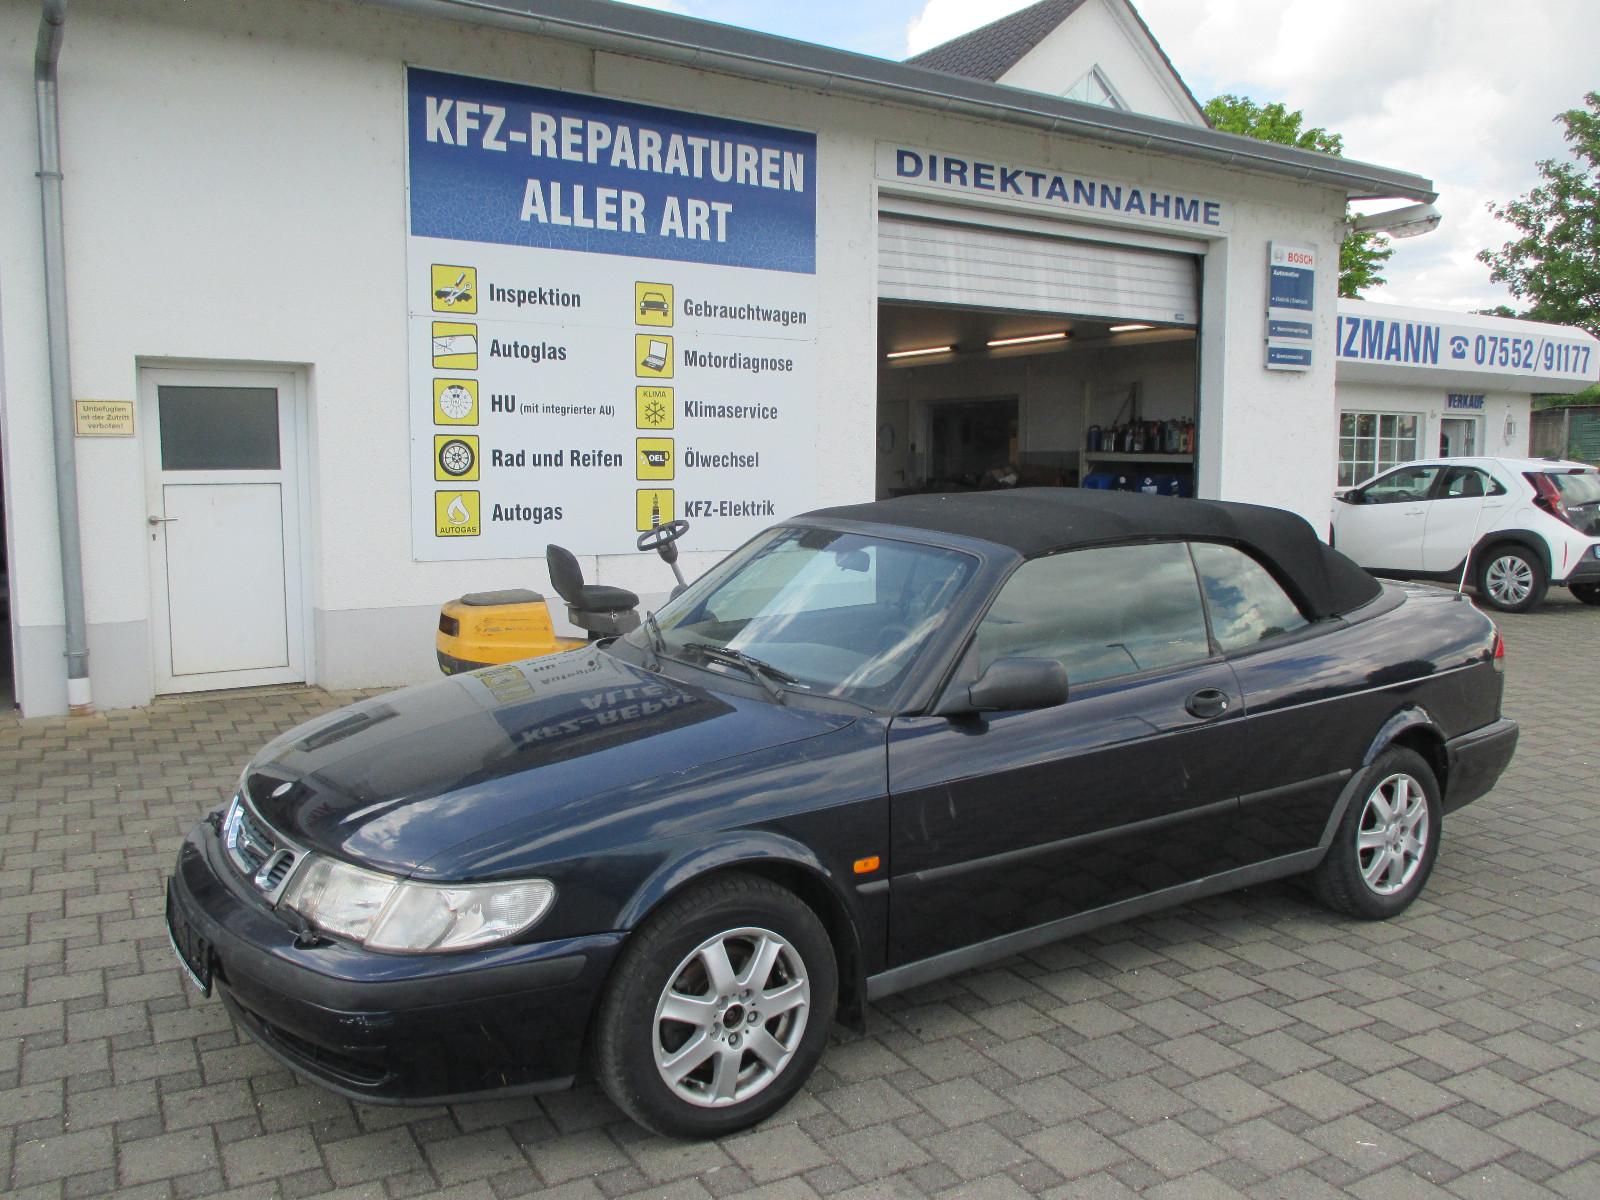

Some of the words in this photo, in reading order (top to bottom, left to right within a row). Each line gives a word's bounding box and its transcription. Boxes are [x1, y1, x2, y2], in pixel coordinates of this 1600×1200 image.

[425, 96, 805, 192] KFZ-REPARATUREN
[896, 149, 1221, 226] DIREKTANNAHME
[520, 179, 647, 235] ALLER
[659, 196, 733, 243] ART
[1287, 252, 1313, 265] BOSCH
[489, 283, 581, 308] Inspektion
[683, 298, 807, 327] Gebrauchtwagen
[490, 338, 567, 363] Autoglas
[684, 349, 793, 374] Motordiagnose
[1474, 334, 1591, 375] 07552/91177
[642, 390, 667, 399] KLIMA
[1448, 393, 1485, 410] VERKAUF
[491, 394, 516, 414] HU
[519, 403, 539, 416] (mit
[542, 403, 596, 417] integrierter
[599, 405, 615, 418] AU)
[684, 400, 778, 420] Klimaservice
[491, 449, 526, 468] Rad
[532, 449, 564, 468] und
[570, 449, 623, 468] Reifen
[648, 454, 665, 463] OEL
[684, 447, 760, 468] Ölwechsel
[491, 503, 563, 525] Autogas
[684, 499, 775, 518] KFZ-Elektrik
[439, 526, 477, 535] AUTOGAS
